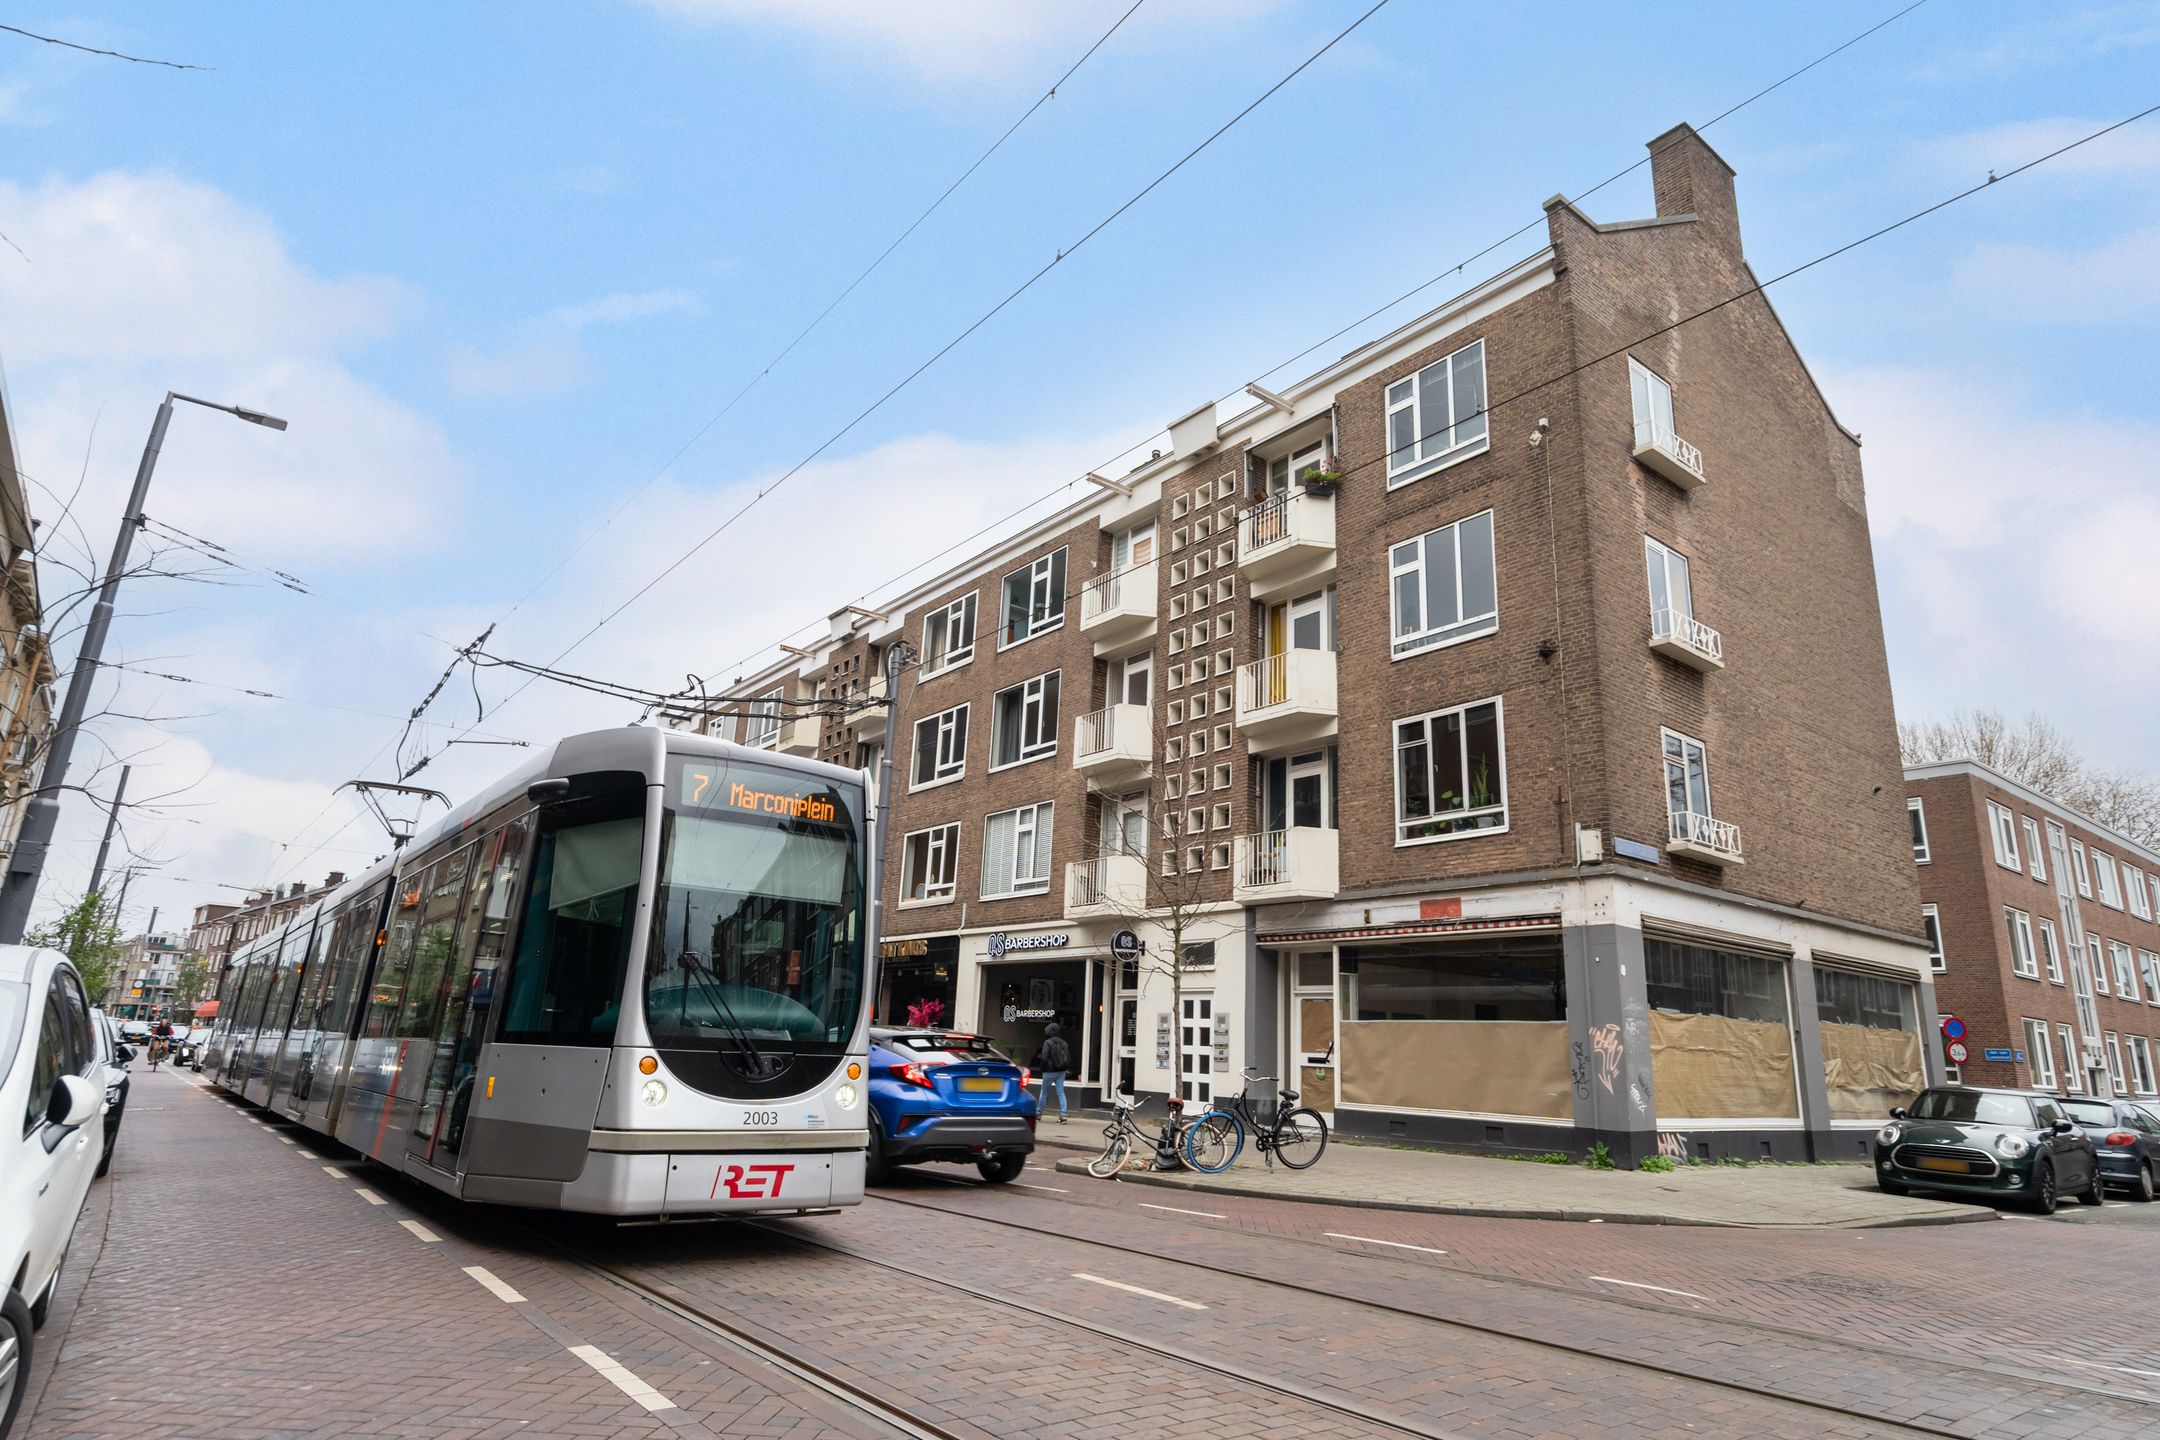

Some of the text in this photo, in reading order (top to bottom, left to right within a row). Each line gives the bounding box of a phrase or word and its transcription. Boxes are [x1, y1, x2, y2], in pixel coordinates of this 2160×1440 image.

[693, 774, 834, 821] 7 Marconiplein
[1005, 934, 1067, 949] BARBERSHOP
[743, 1112, 778, 1125] 2003
[710, 1165, 795, 1199] RET
